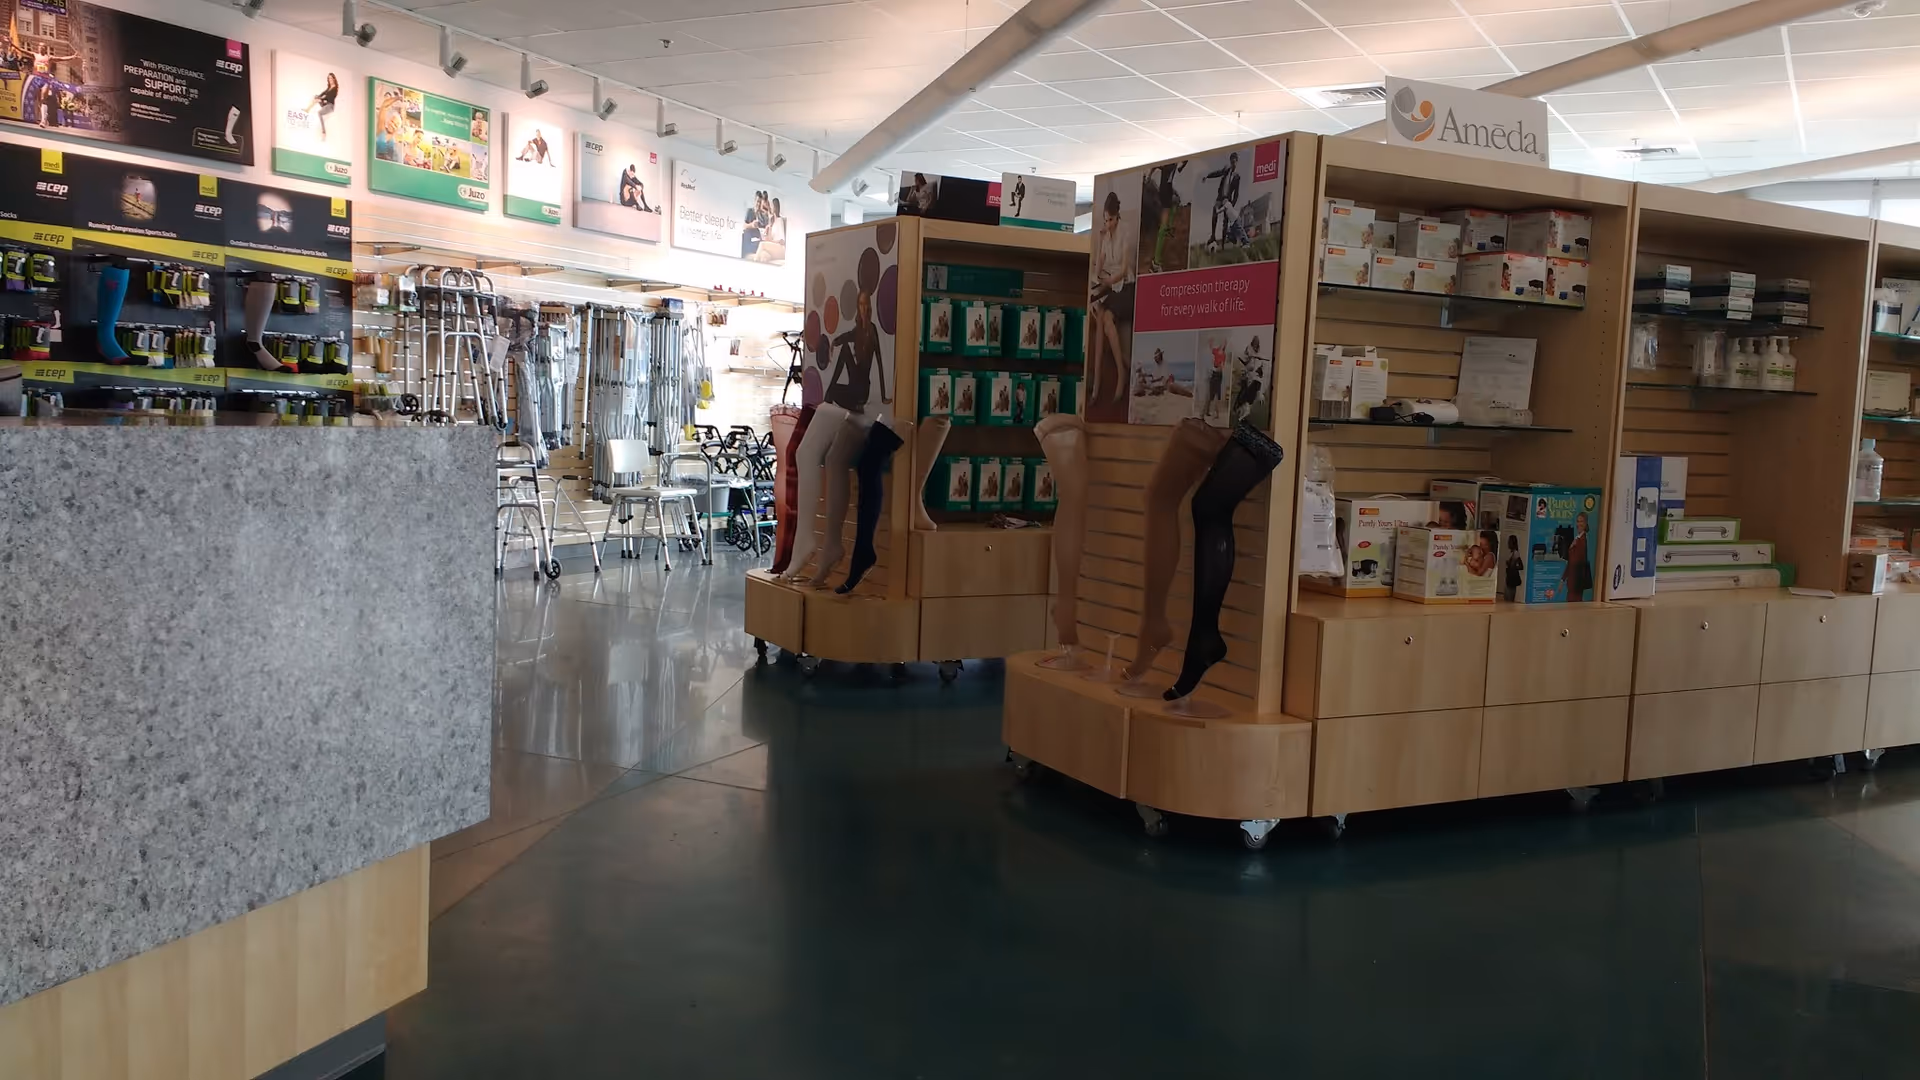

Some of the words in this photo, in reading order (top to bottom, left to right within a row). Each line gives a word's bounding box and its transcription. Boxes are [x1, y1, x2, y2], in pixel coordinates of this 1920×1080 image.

[123, 64, 175, 83] PREPARATION
[129, 87, 154, 98] capable
[287, 109, 310, 121] EASY
[333, 164, 348, 175] Juzo
[1256, 159, 1277, 174] medi
[47, 182, 69, 195] cep
[468, 187, 486, 200] Juzo
[0, 210, 17, 219] Socks
[204, 205, 223, 216] cep
[679, 204, 703, 223] Better
[704, 212, 725, 230] sleep
[726, 216, 737, 230] for
[335, 225, 351, 236] cep
[44, 232, 65, 245] cep
[201, 250, 219, 262] cep
[332, 266, 348, 277] cep
[1159, 281, 1214, 298] Compression
[1215, 277, 1251, 295] therapy
[1160, 303, 1173, 317] for
[1173, 302, 1197, 318] every
[1197, 298, 1218, 314] walk
[1218, 297, 1230, 314] of
[1230, 298, 1247, 312] life.
[45, 368, 66, 380] cep
[202, 373, 220, 385] cep
[333, 377, 349, 388] cep
